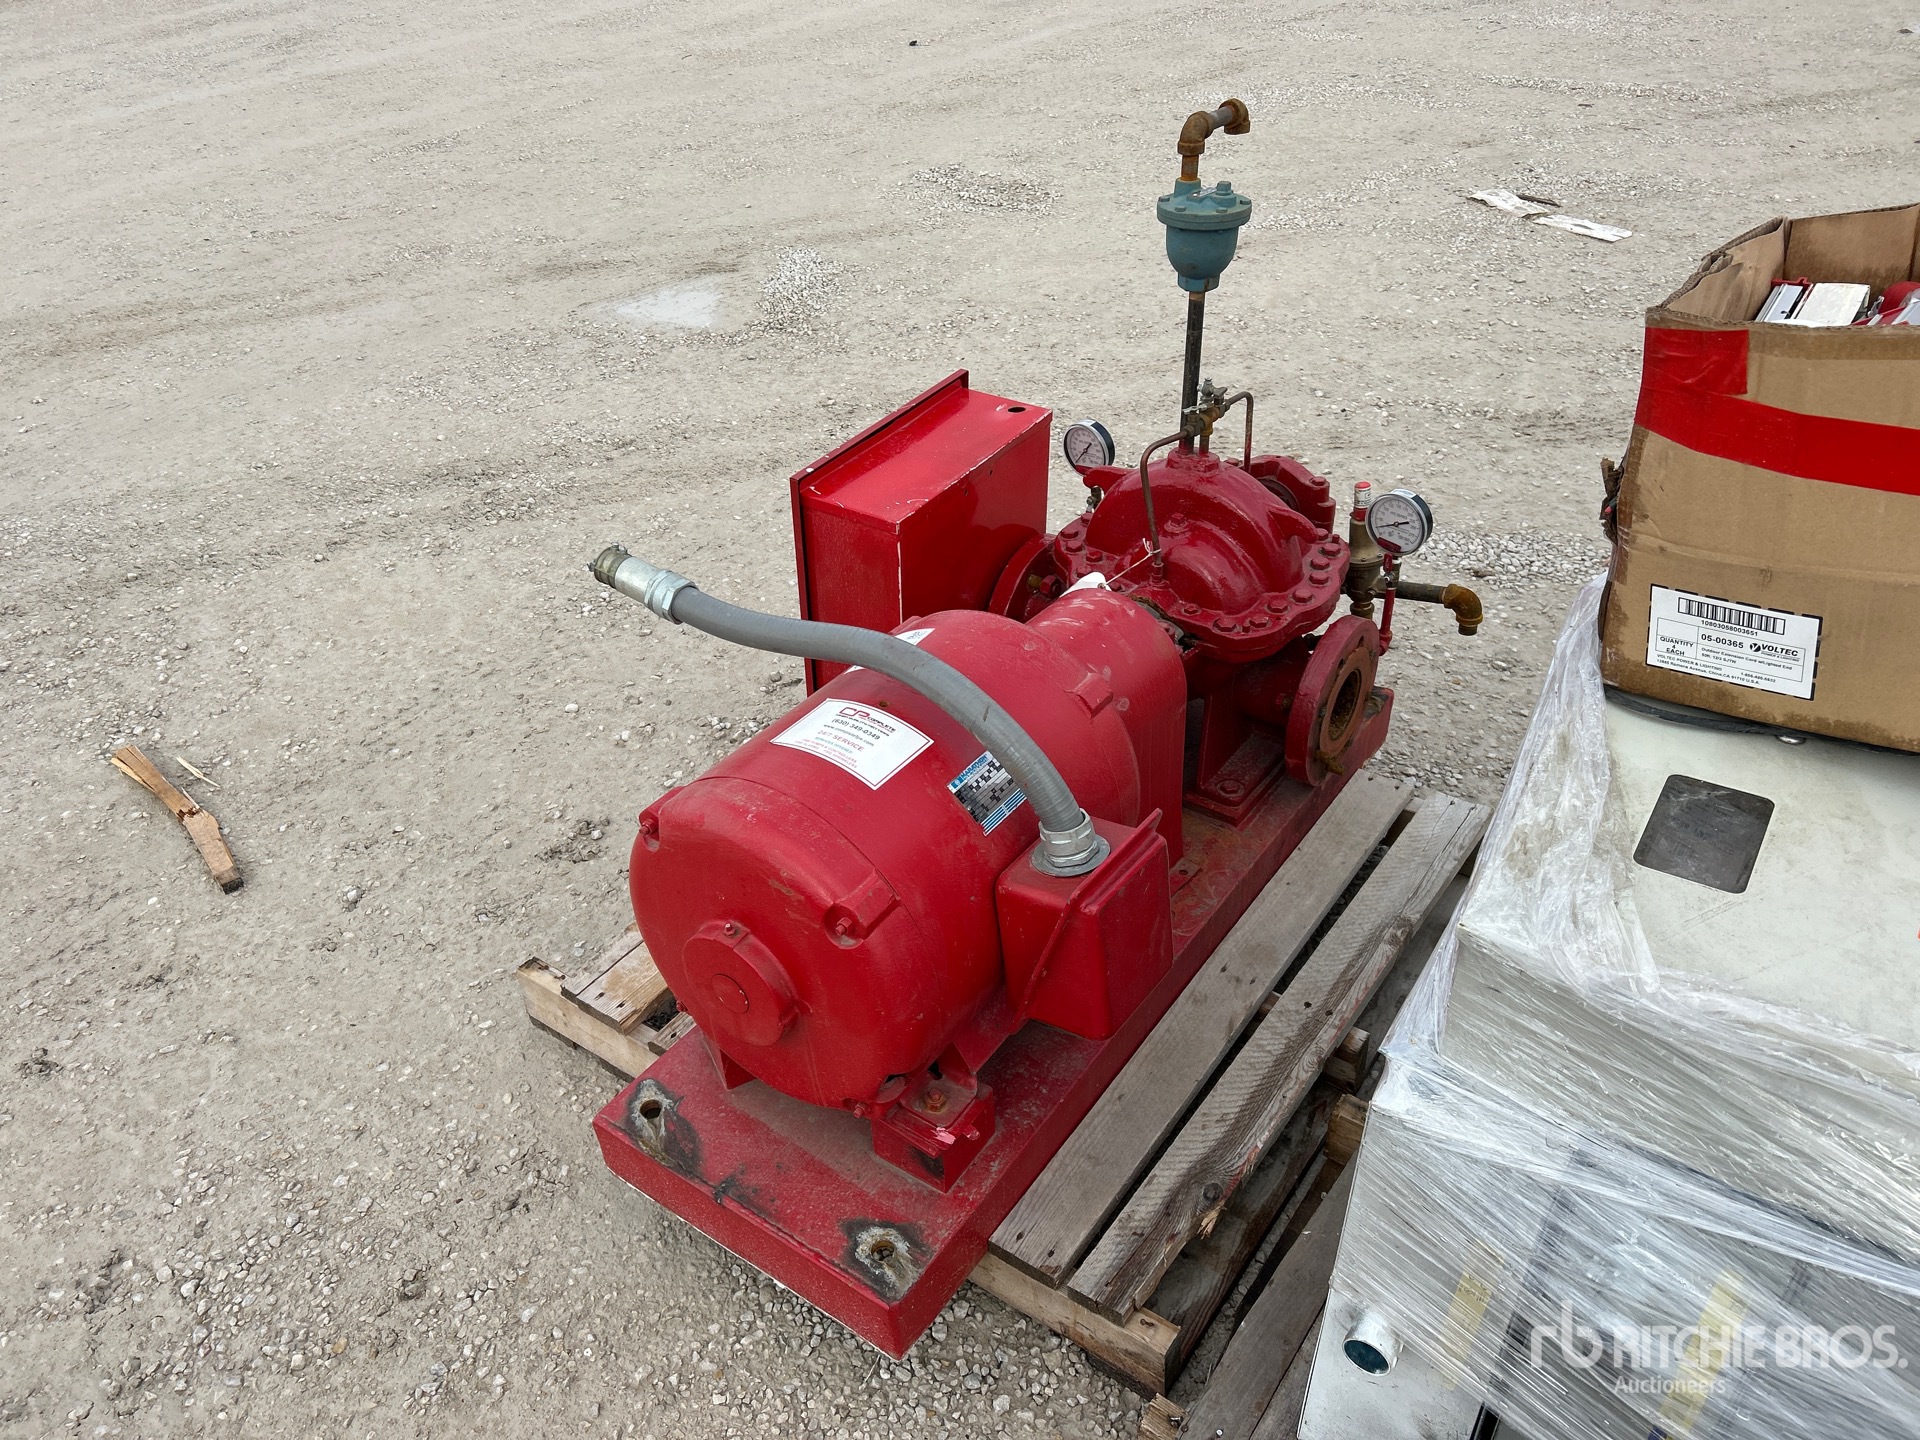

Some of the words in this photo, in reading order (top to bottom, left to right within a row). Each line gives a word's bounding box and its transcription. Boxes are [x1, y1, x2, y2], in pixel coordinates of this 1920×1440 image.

[1701, 619, 1758, 636] 10803058003651
[1660, 636, 1694, 648] QUANTITY
[1701, 633, 1744, 649] 05-00365
[1657, 653, 1675, 662] VOLTEC
[1666, 647, 1685, 656] EACH
[1701, 647, 1720, 655] Outdoor
[1721, 651, 1744, 660] Extension
[1761, 643, 1799, 657] VOLTEC
[850, 723, 880, 740] 349-0349
[867, 716, 896, 732] COMPLETE
[832, 734, 865, 752] SERVICE
